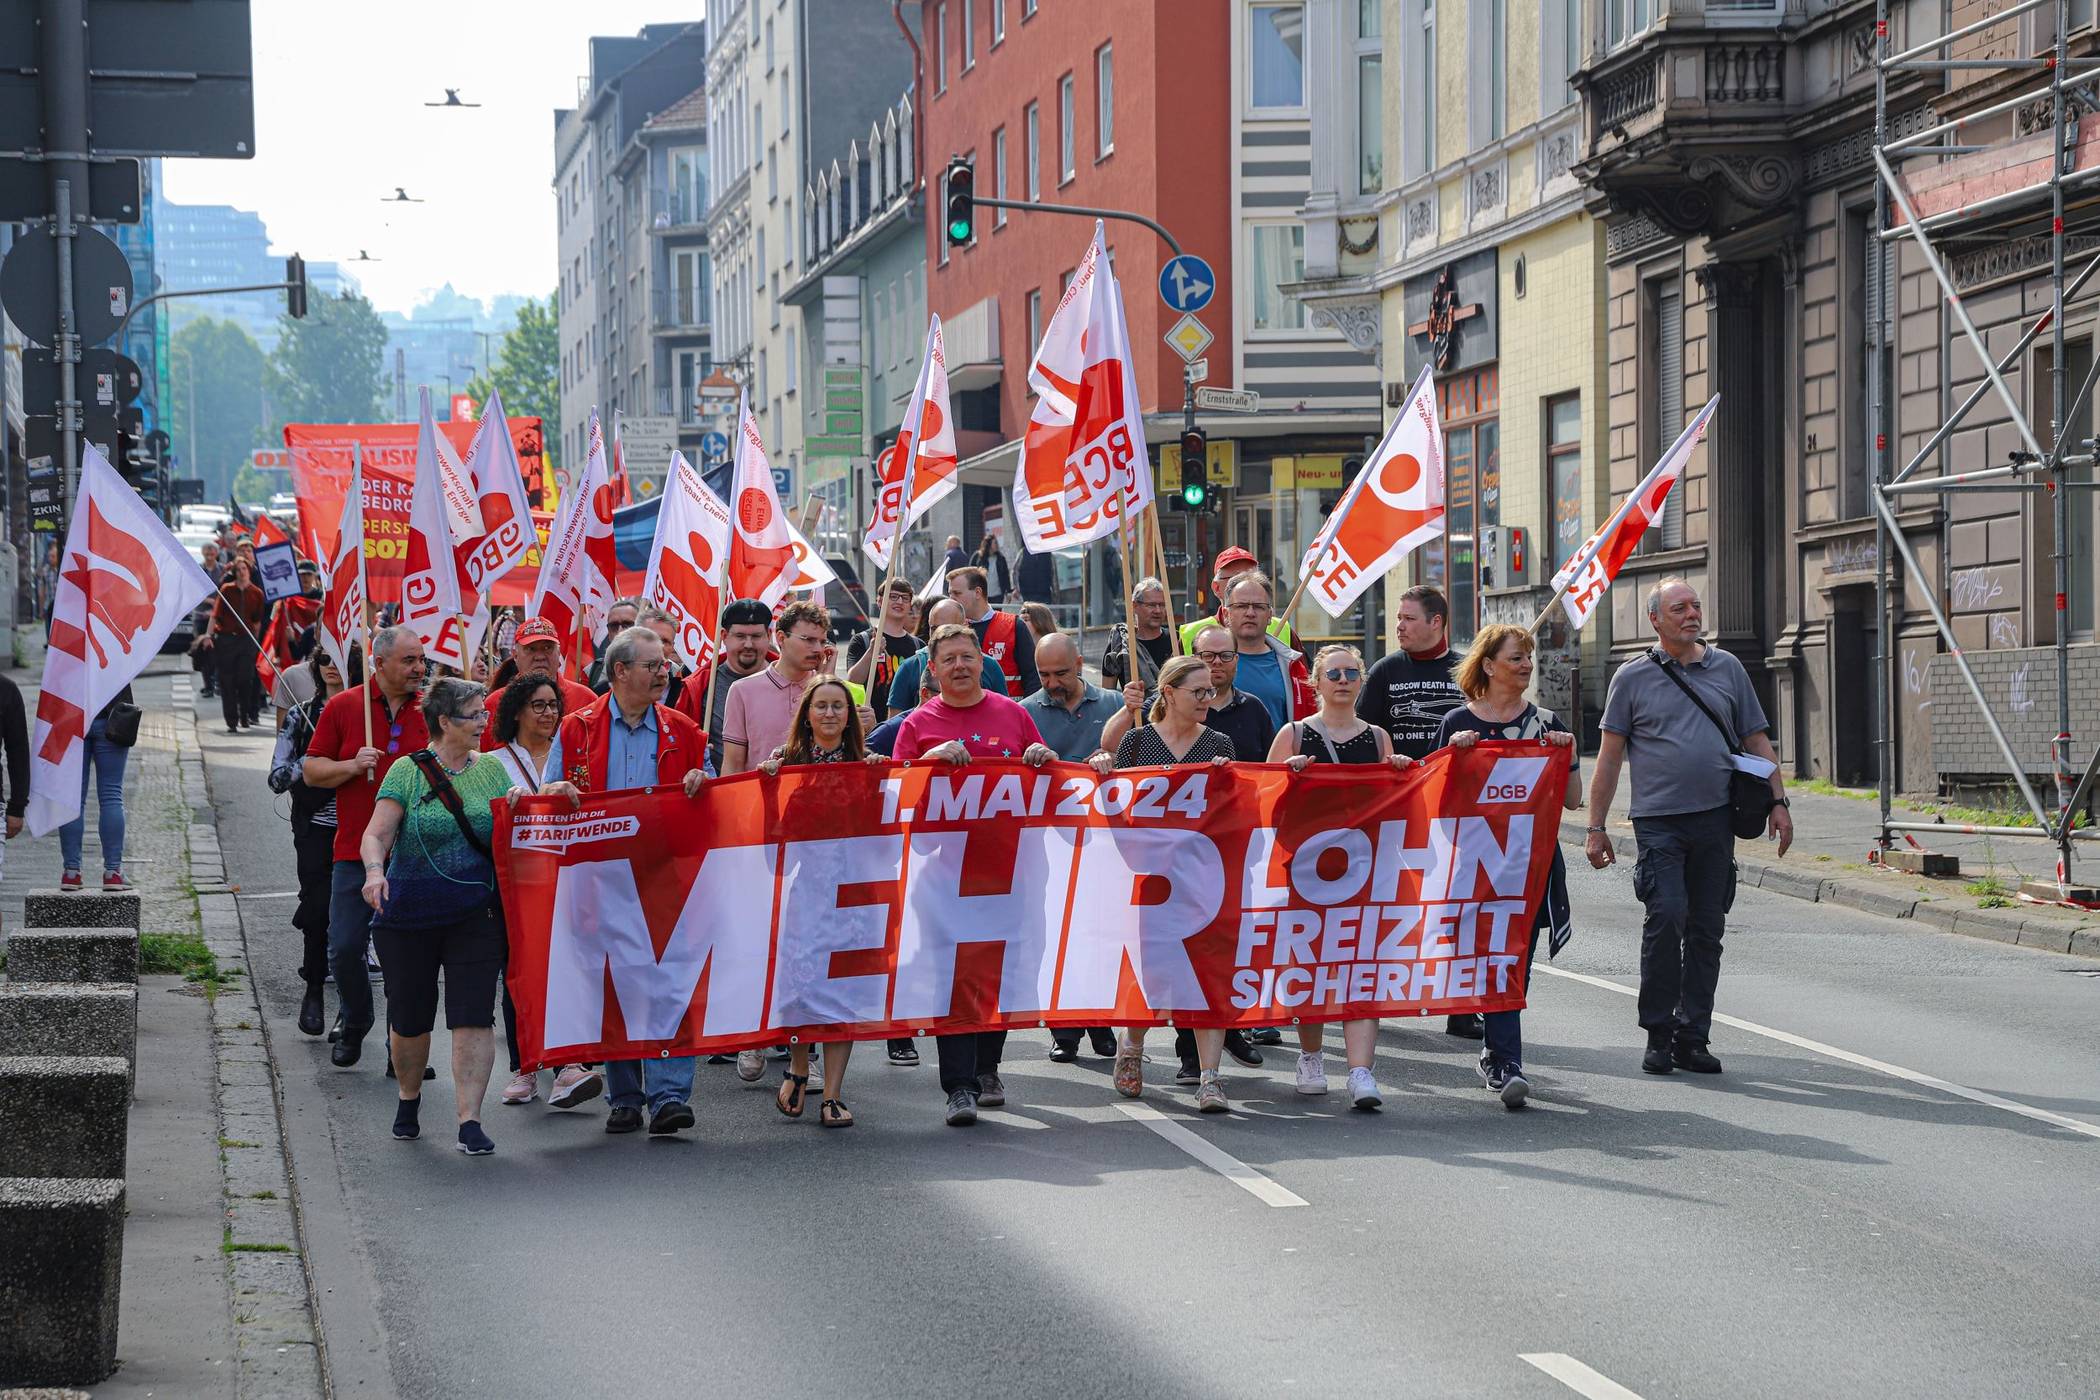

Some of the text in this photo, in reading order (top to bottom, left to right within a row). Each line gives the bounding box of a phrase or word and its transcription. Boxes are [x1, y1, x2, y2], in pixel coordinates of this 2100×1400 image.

[1207, 393, 1248, 407] Ernststraße
[1297, 469, 1326, 479] Neu-
[362, 480, 392, 495] DER
[32, 504, 62, 516] ZKIN
[1389, 682, 1420, 691] MOSCOW
[1422, 681, 1446, 689] DEATH
[1393, 732, 1405, 741] NO
[1406, 732, 1425, 740] ONE
[879, 773, 1209, 824] 1. MAI 2024
[1486, 784, 1528, 800] DGB
[513, 810, 607, 823] EINTRETEN FÜR DIE
[517, 820, 632, 841] #TARIFWENDE
[1241, 813, 1535, 909] LOHN
[543, 826, 1226, 1050] MEHR
[1234, 900, 1527, 967] FREIZEIT
[1230, 955, 1520, 1009] SICHERHEIT
